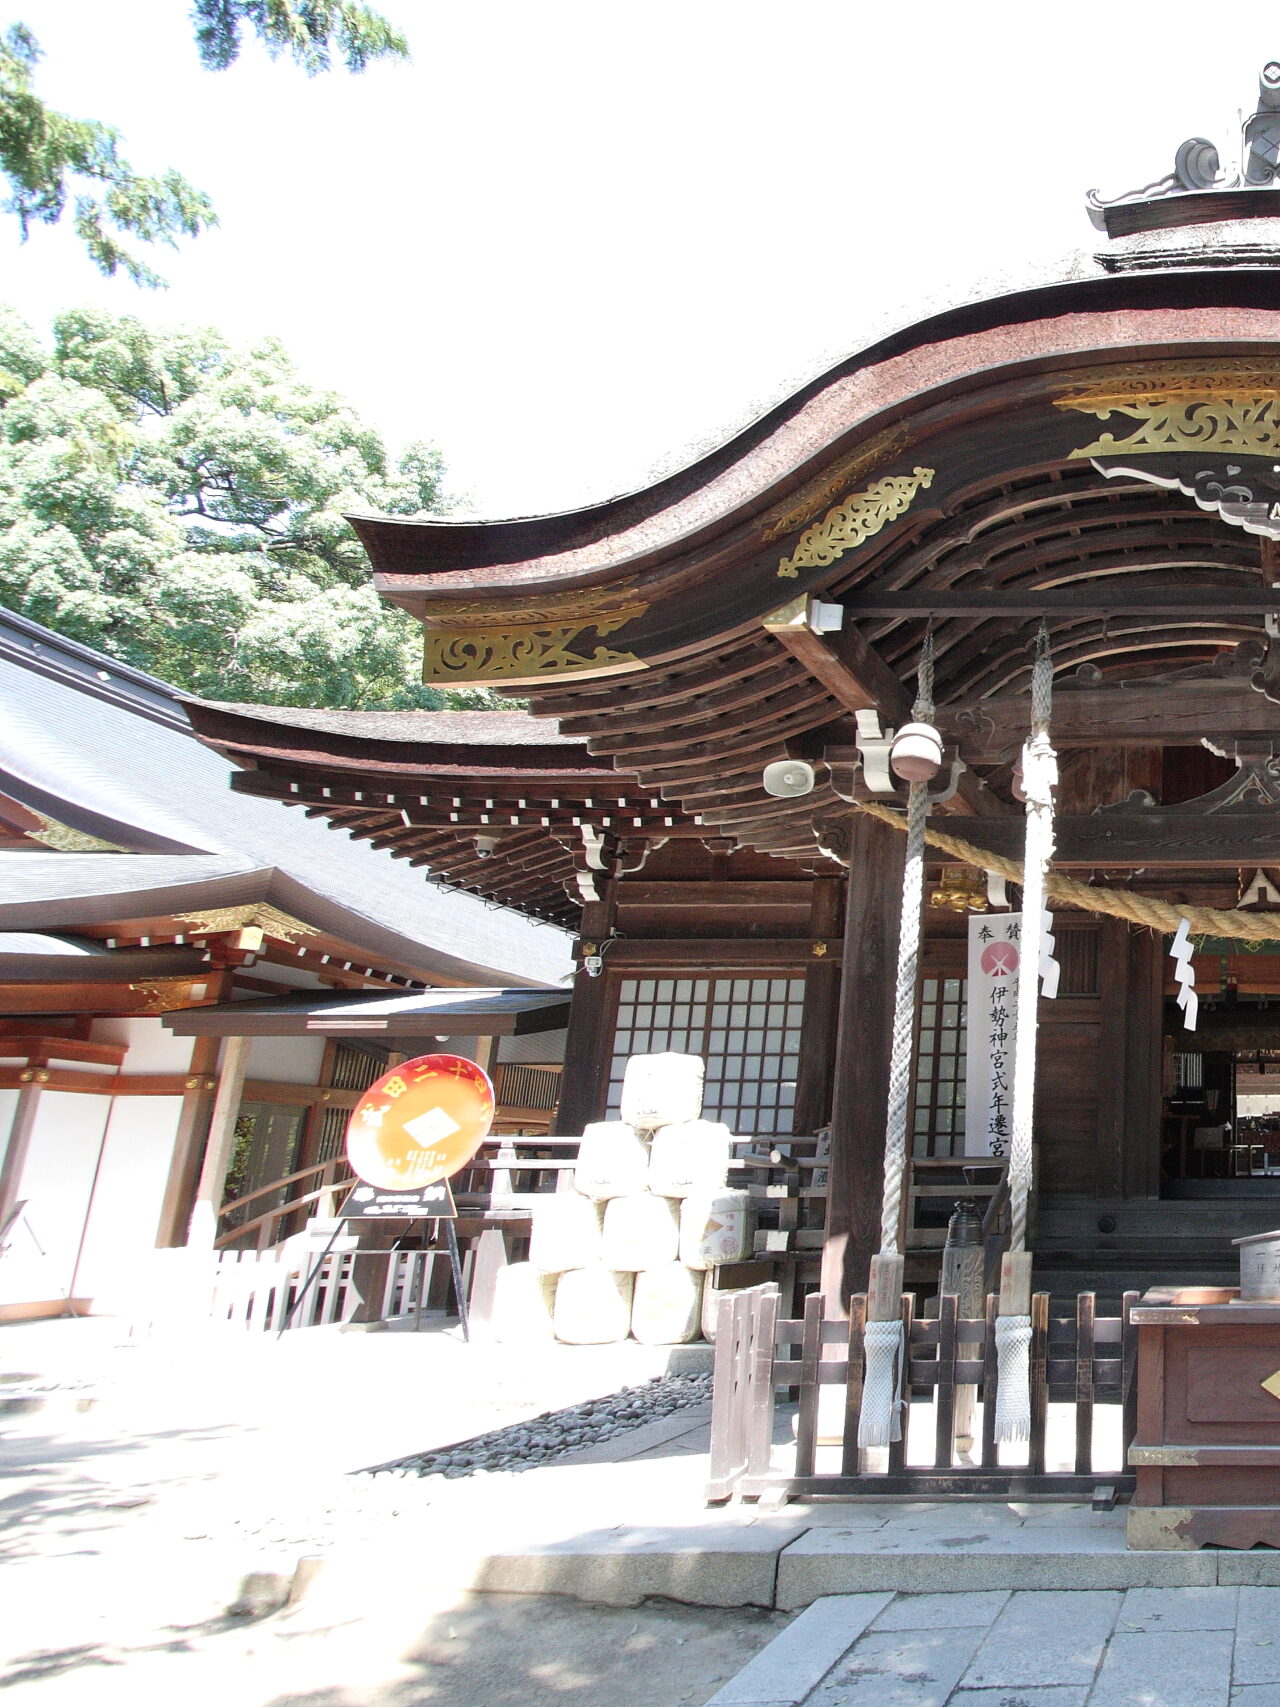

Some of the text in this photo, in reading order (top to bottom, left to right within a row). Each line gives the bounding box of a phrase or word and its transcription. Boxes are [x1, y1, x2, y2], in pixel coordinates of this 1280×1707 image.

[988, 985, 1011, 1158] 伊勢神宮式年遷宮
